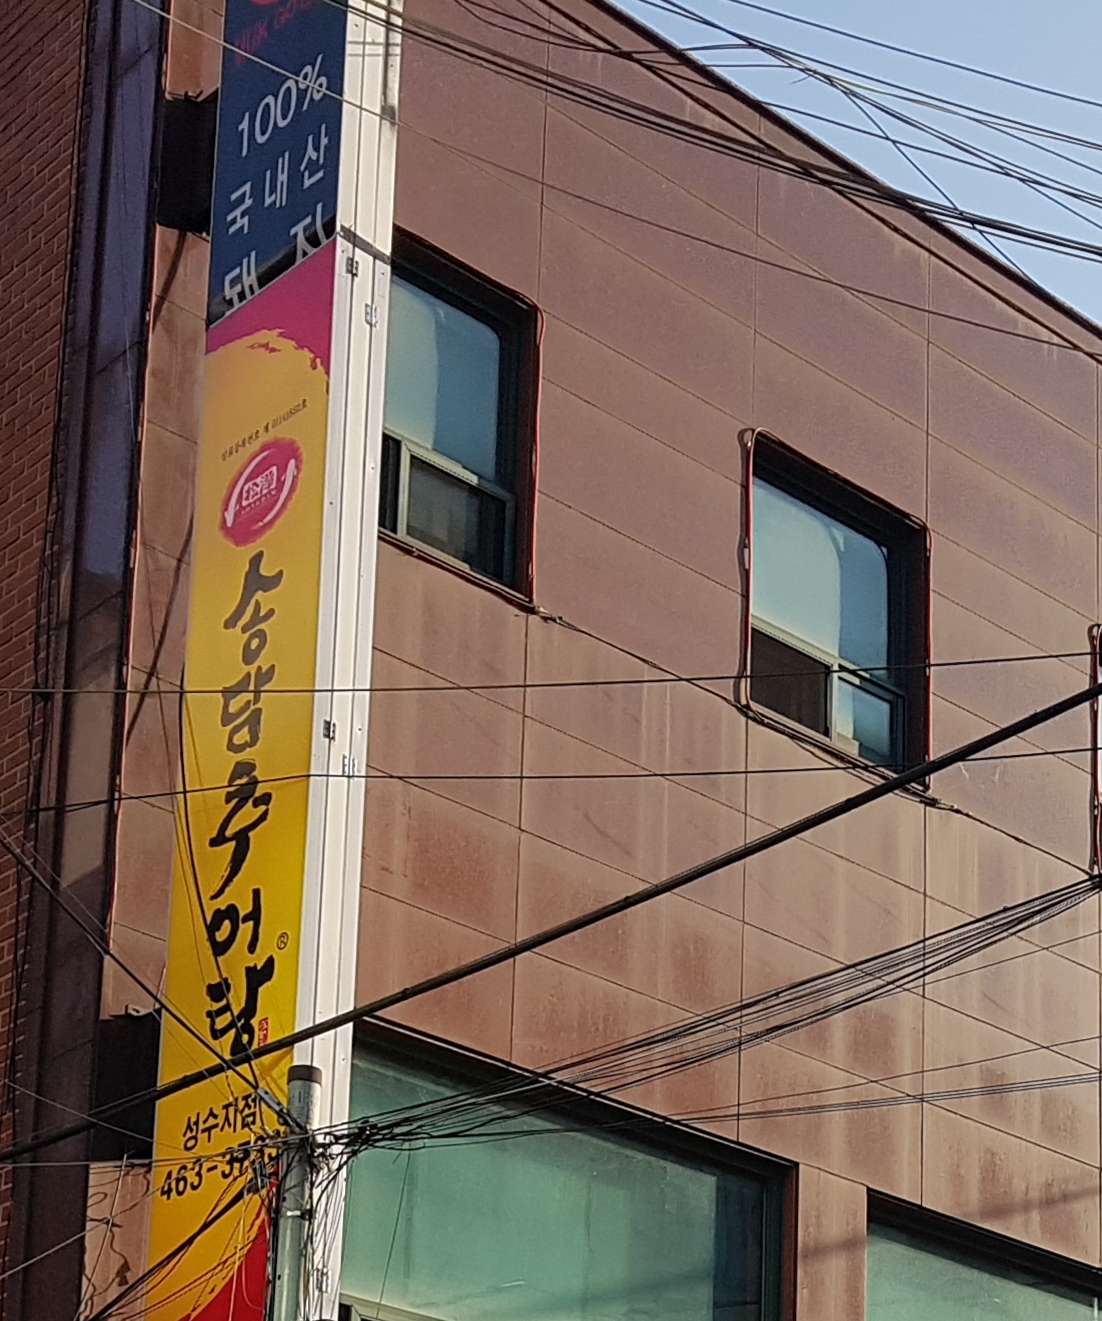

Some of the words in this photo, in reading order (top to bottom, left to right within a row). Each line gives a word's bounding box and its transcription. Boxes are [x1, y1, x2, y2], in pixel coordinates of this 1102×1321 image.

[237, 53, 327, 158] 100%
[227, 124, 328, 235] 국내산
[205, 550, 284, 1062] 송담추어탕
